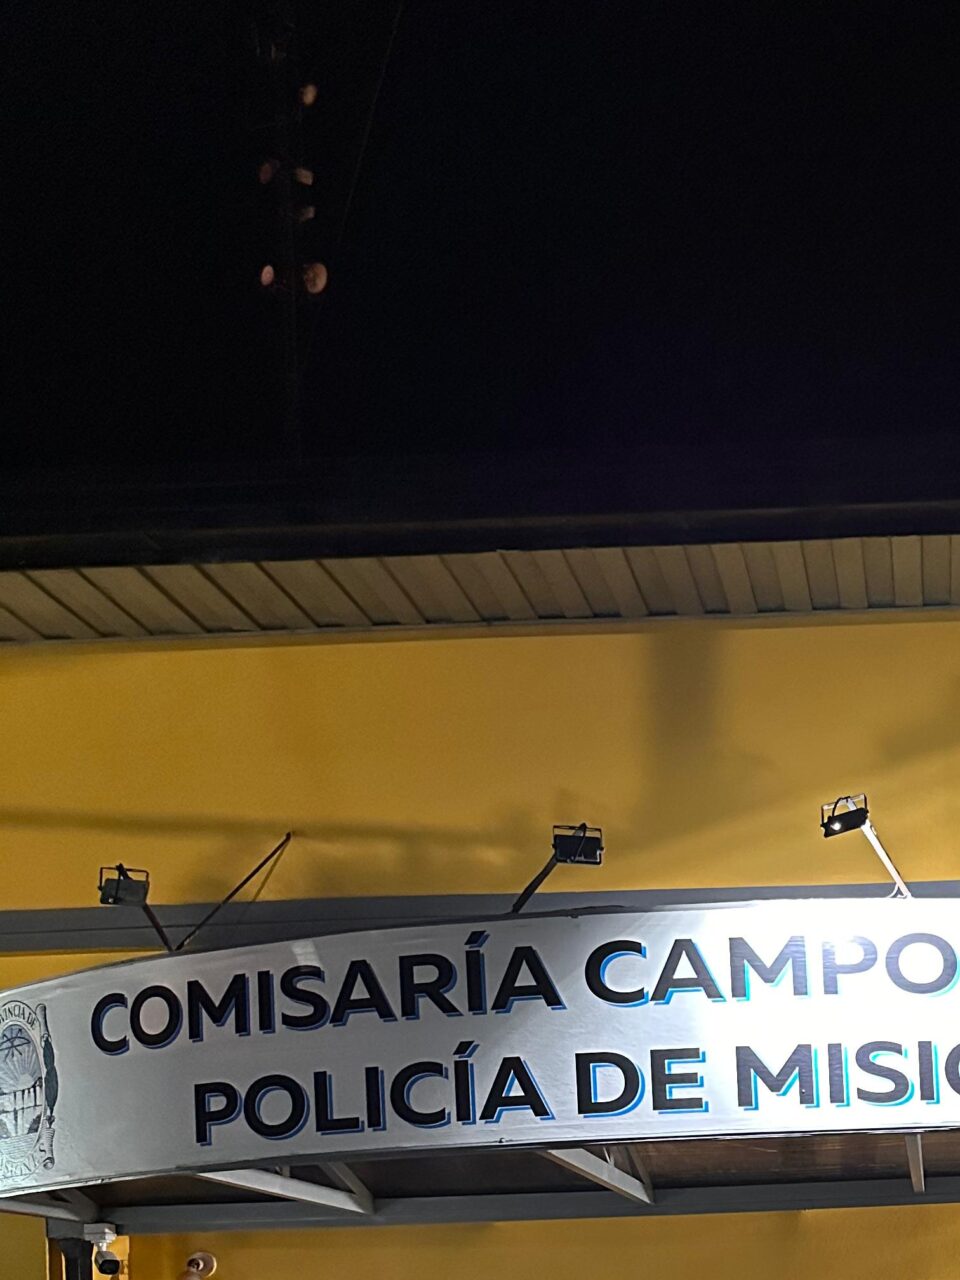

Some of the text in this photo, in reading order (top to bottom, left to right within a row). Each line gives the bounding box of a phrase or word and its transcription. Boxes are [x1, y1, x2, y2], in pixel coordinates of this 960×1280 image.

[91, 930, 569, 1056] COMISARÍA
[194, 1040, 556, 1146] POLICÍA
[575, 1047, 709, 1119] DE
